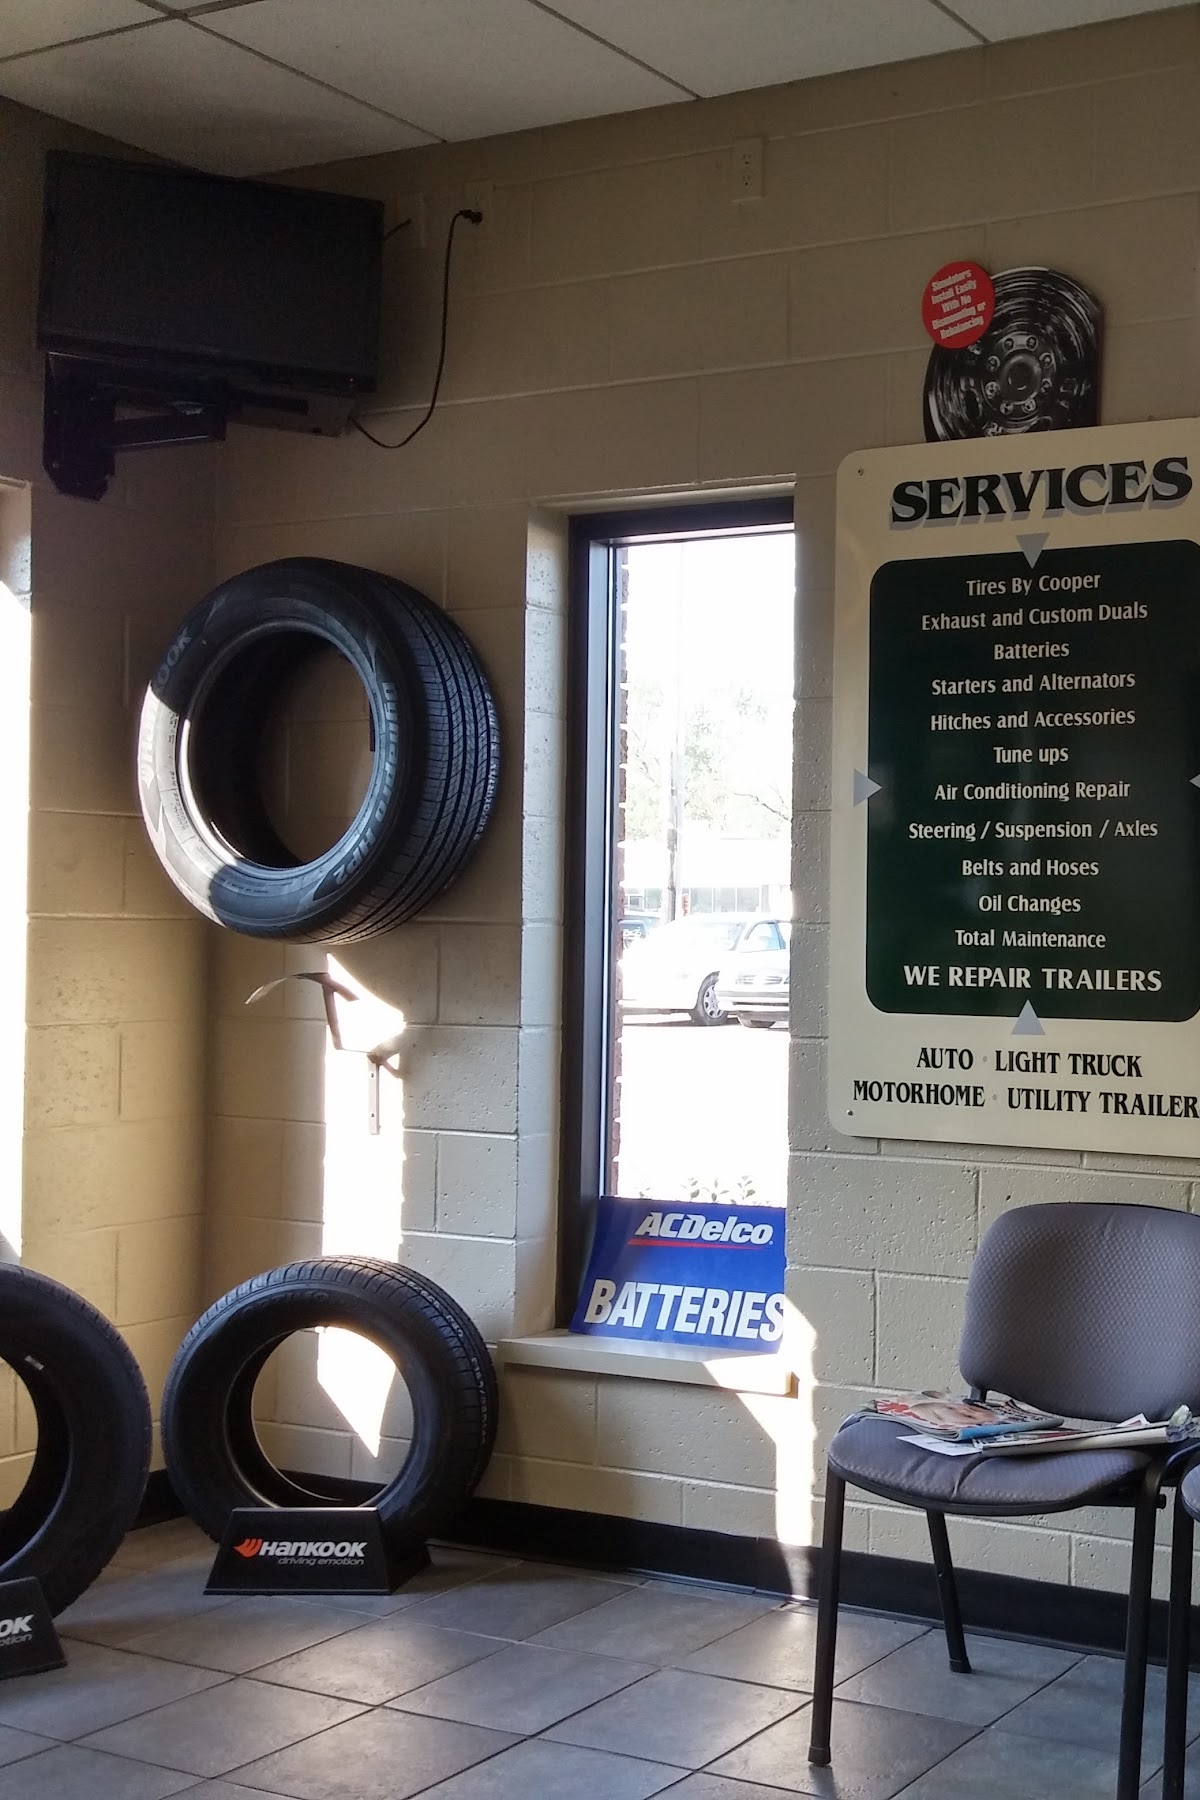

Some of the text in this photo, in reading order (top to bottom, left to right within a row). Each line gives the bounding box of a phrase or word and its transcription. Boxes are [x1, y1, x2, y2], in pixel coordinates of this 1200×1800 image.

[890, 457, 1192, 526] SERVICES
[967, 574, 1101, 596] Tires By Cooper
[922, 602, 1148, 631] Exhaust and Custom Duals
[994, 643, 1070, 661] Batteries
[932, 672, 1136, 695] Starters and Alternators
[930, 708, 1136, 731] Hitches and Accessories
[994, 746, 1069, 766] Tune ups
[935, 781, 1130, 802] Air Conditioning Repair
[909, 819, 1158, 841] Steering / Suspension / Axles
[962, 859, 1099, 876] Belts and Hoses
[979, 895, 1081, 915] Oil Changes
[955, 929, 1106, 948] Total Maintenance
[904, 965, 1162, 991] WE REPAIR TRAILERS
[916, 1048, 1143, 1078] AUTO LIGHT TRUCK
[853, 1080, 985, 1107] MOTORHOME
[1007, 1086, 1091, 1113] UTILITY
[635, 1212, 773, 1245] ACDelco
[584, 1279, 784, 1342] BATTERIES
[277, 1557, 365, 1566] driving emotion
